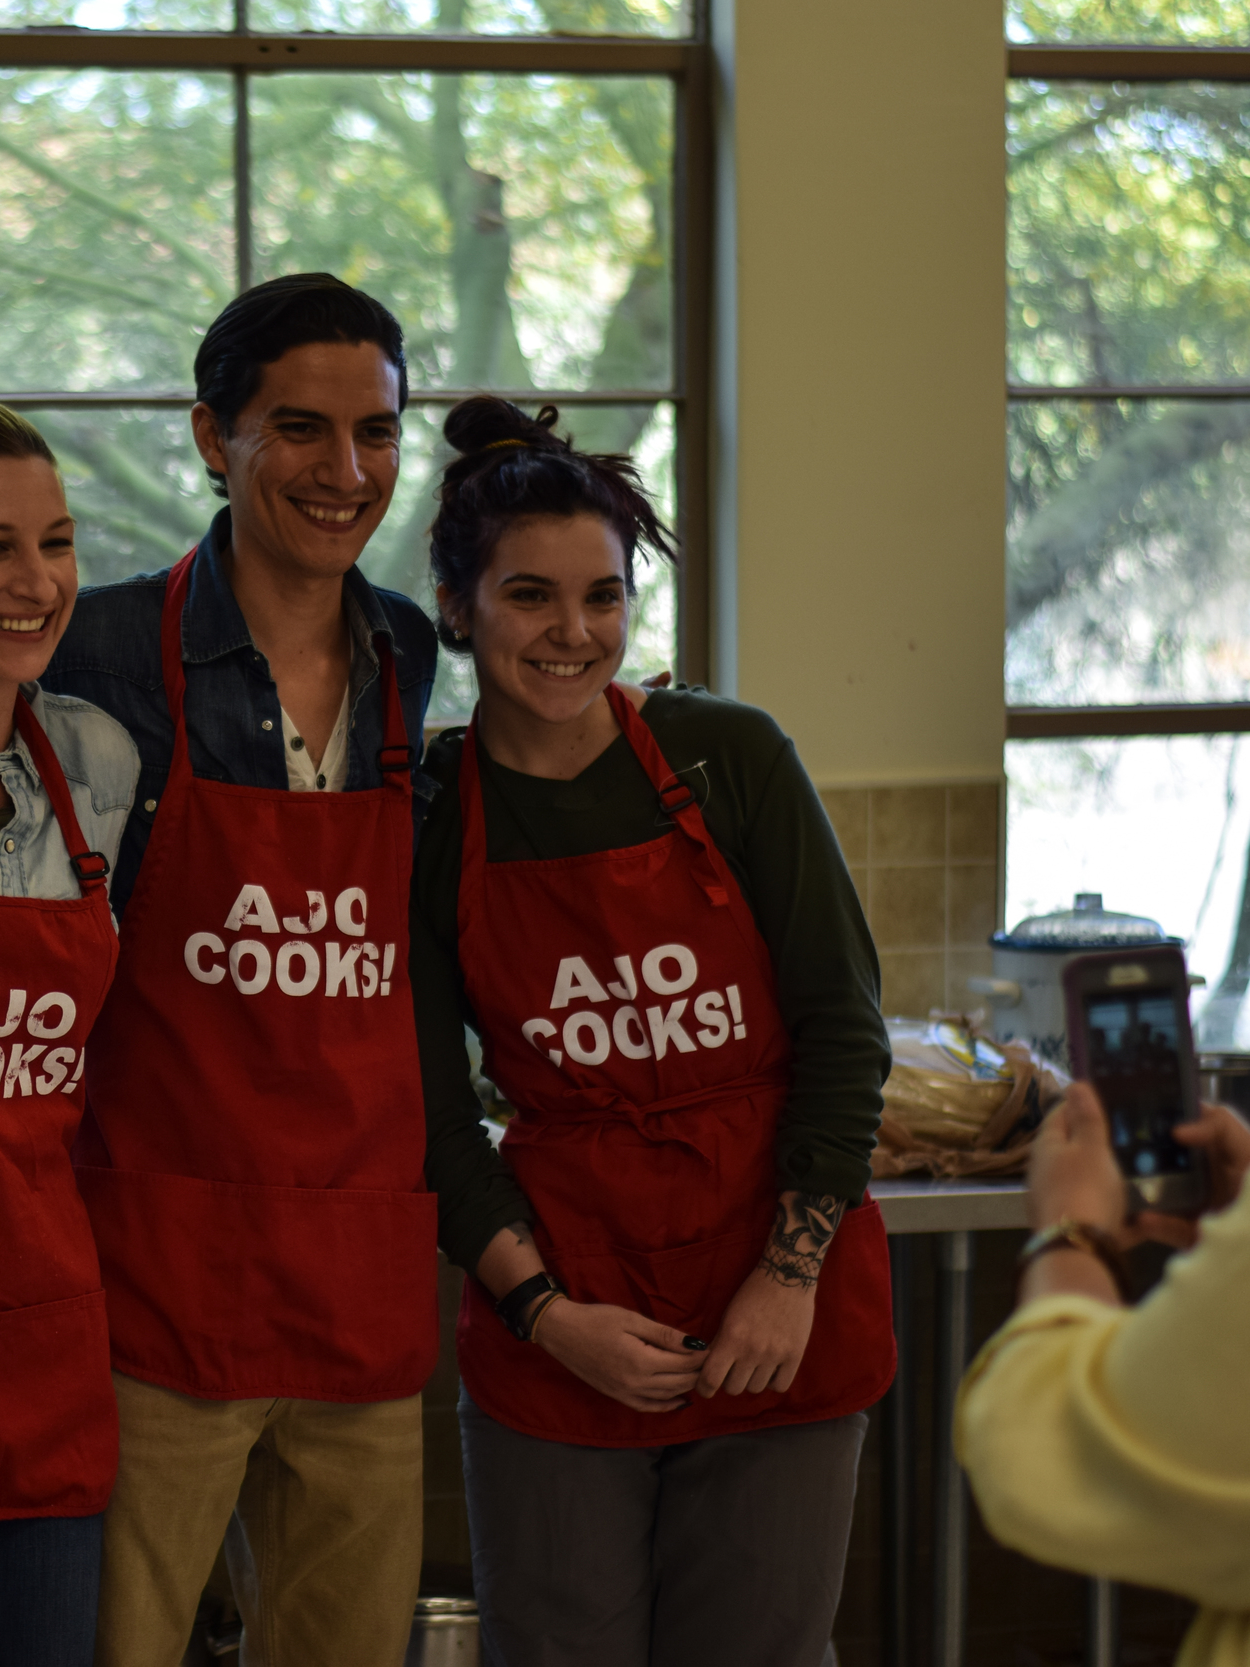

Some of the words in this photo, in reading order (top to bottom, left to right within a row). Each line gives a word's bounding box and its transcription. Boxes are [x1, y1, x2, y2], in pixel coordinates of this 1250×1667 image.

[224, 883, 367, 937] AJO
[184, 932, 395, 999] COOKS!
[550, 943, 697, 1009] AJO
[521, 984, 747, 1068] COOKS!
